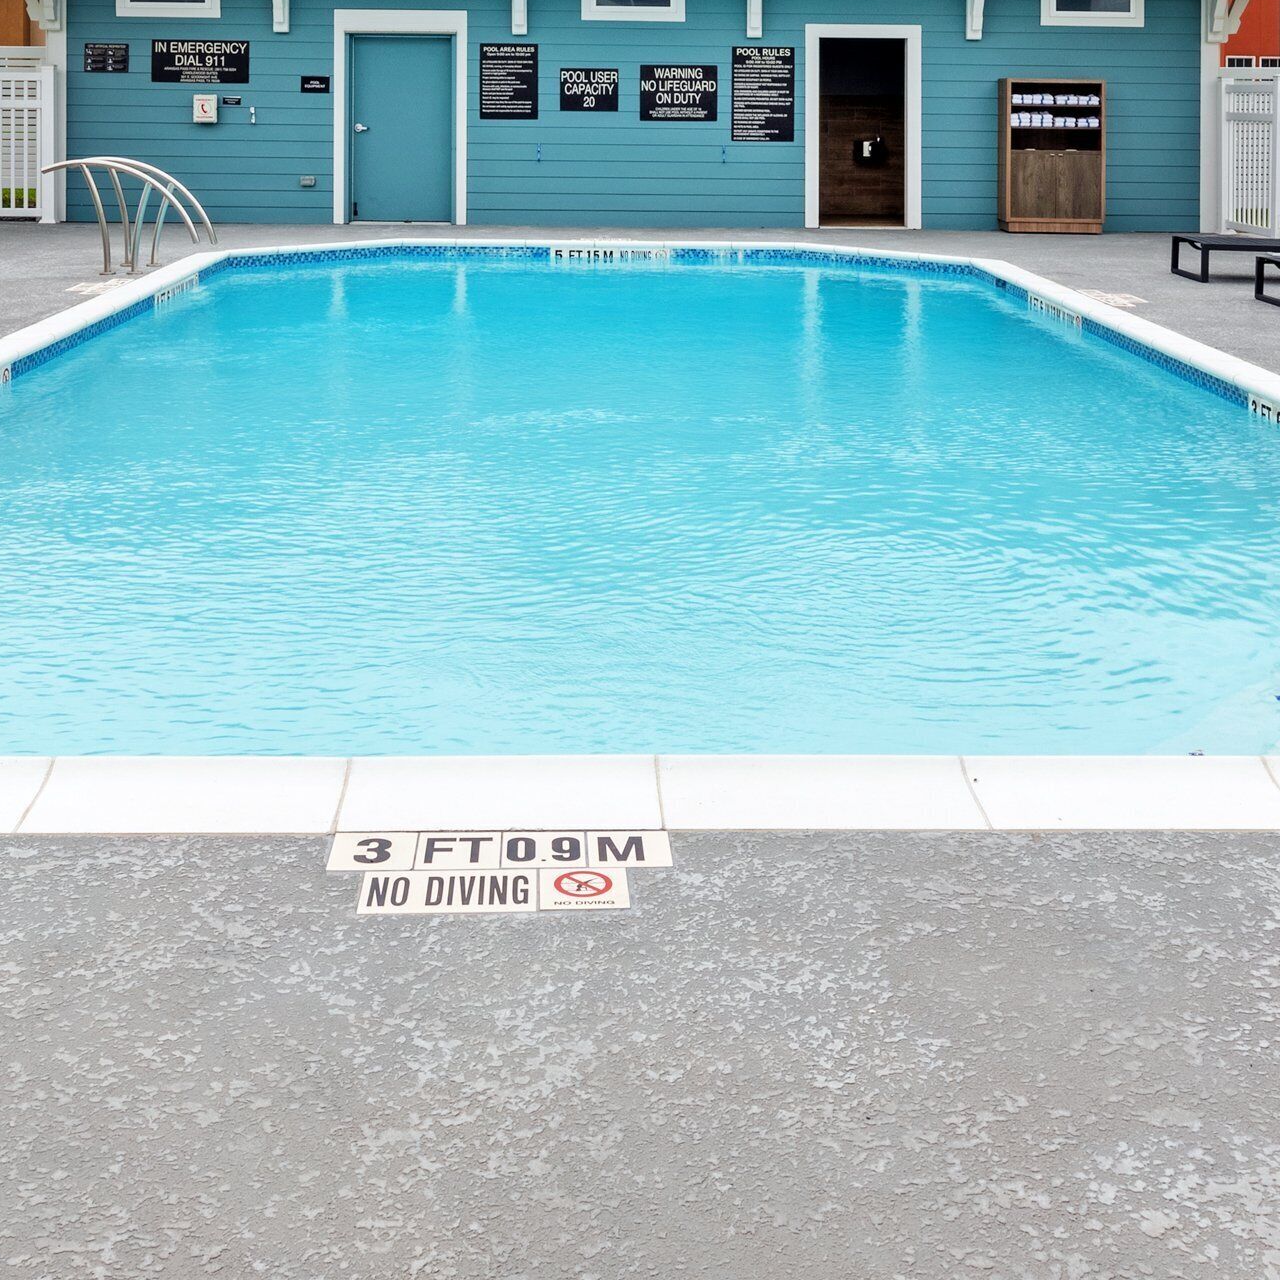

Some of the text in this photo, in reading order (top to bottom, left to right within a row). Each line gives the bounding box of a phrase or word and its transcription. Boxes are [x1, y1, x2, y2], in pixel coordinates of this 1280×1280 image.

[155, 42, 247, 54] IN EMERGENCY
[736, 48, 791, 56] POOL RULES
[175, 55, 225, 66] DIAL 911
[561, 71, 618, 83] POOL USER
[654, 68, 703, 79] WARNING
[565, 84, 614, 95] CAPACITY
[641, 80, 717, 92] NO LIFEGUARD
[583, 96, 595, 107] 20
[656, 93, 702, 104] ON DUTY
[555, 250, 563, 261] 5
[568, 250, 583, 261] FT
[603, 250, 614, 261] M
[1251, 400, 1257, 414] 3
[1261, 403, 1272, 419] FT
[353, 836, 645, 863] 3 FT 0.9 M
[366, 875, 529, 907] NO DIVING
